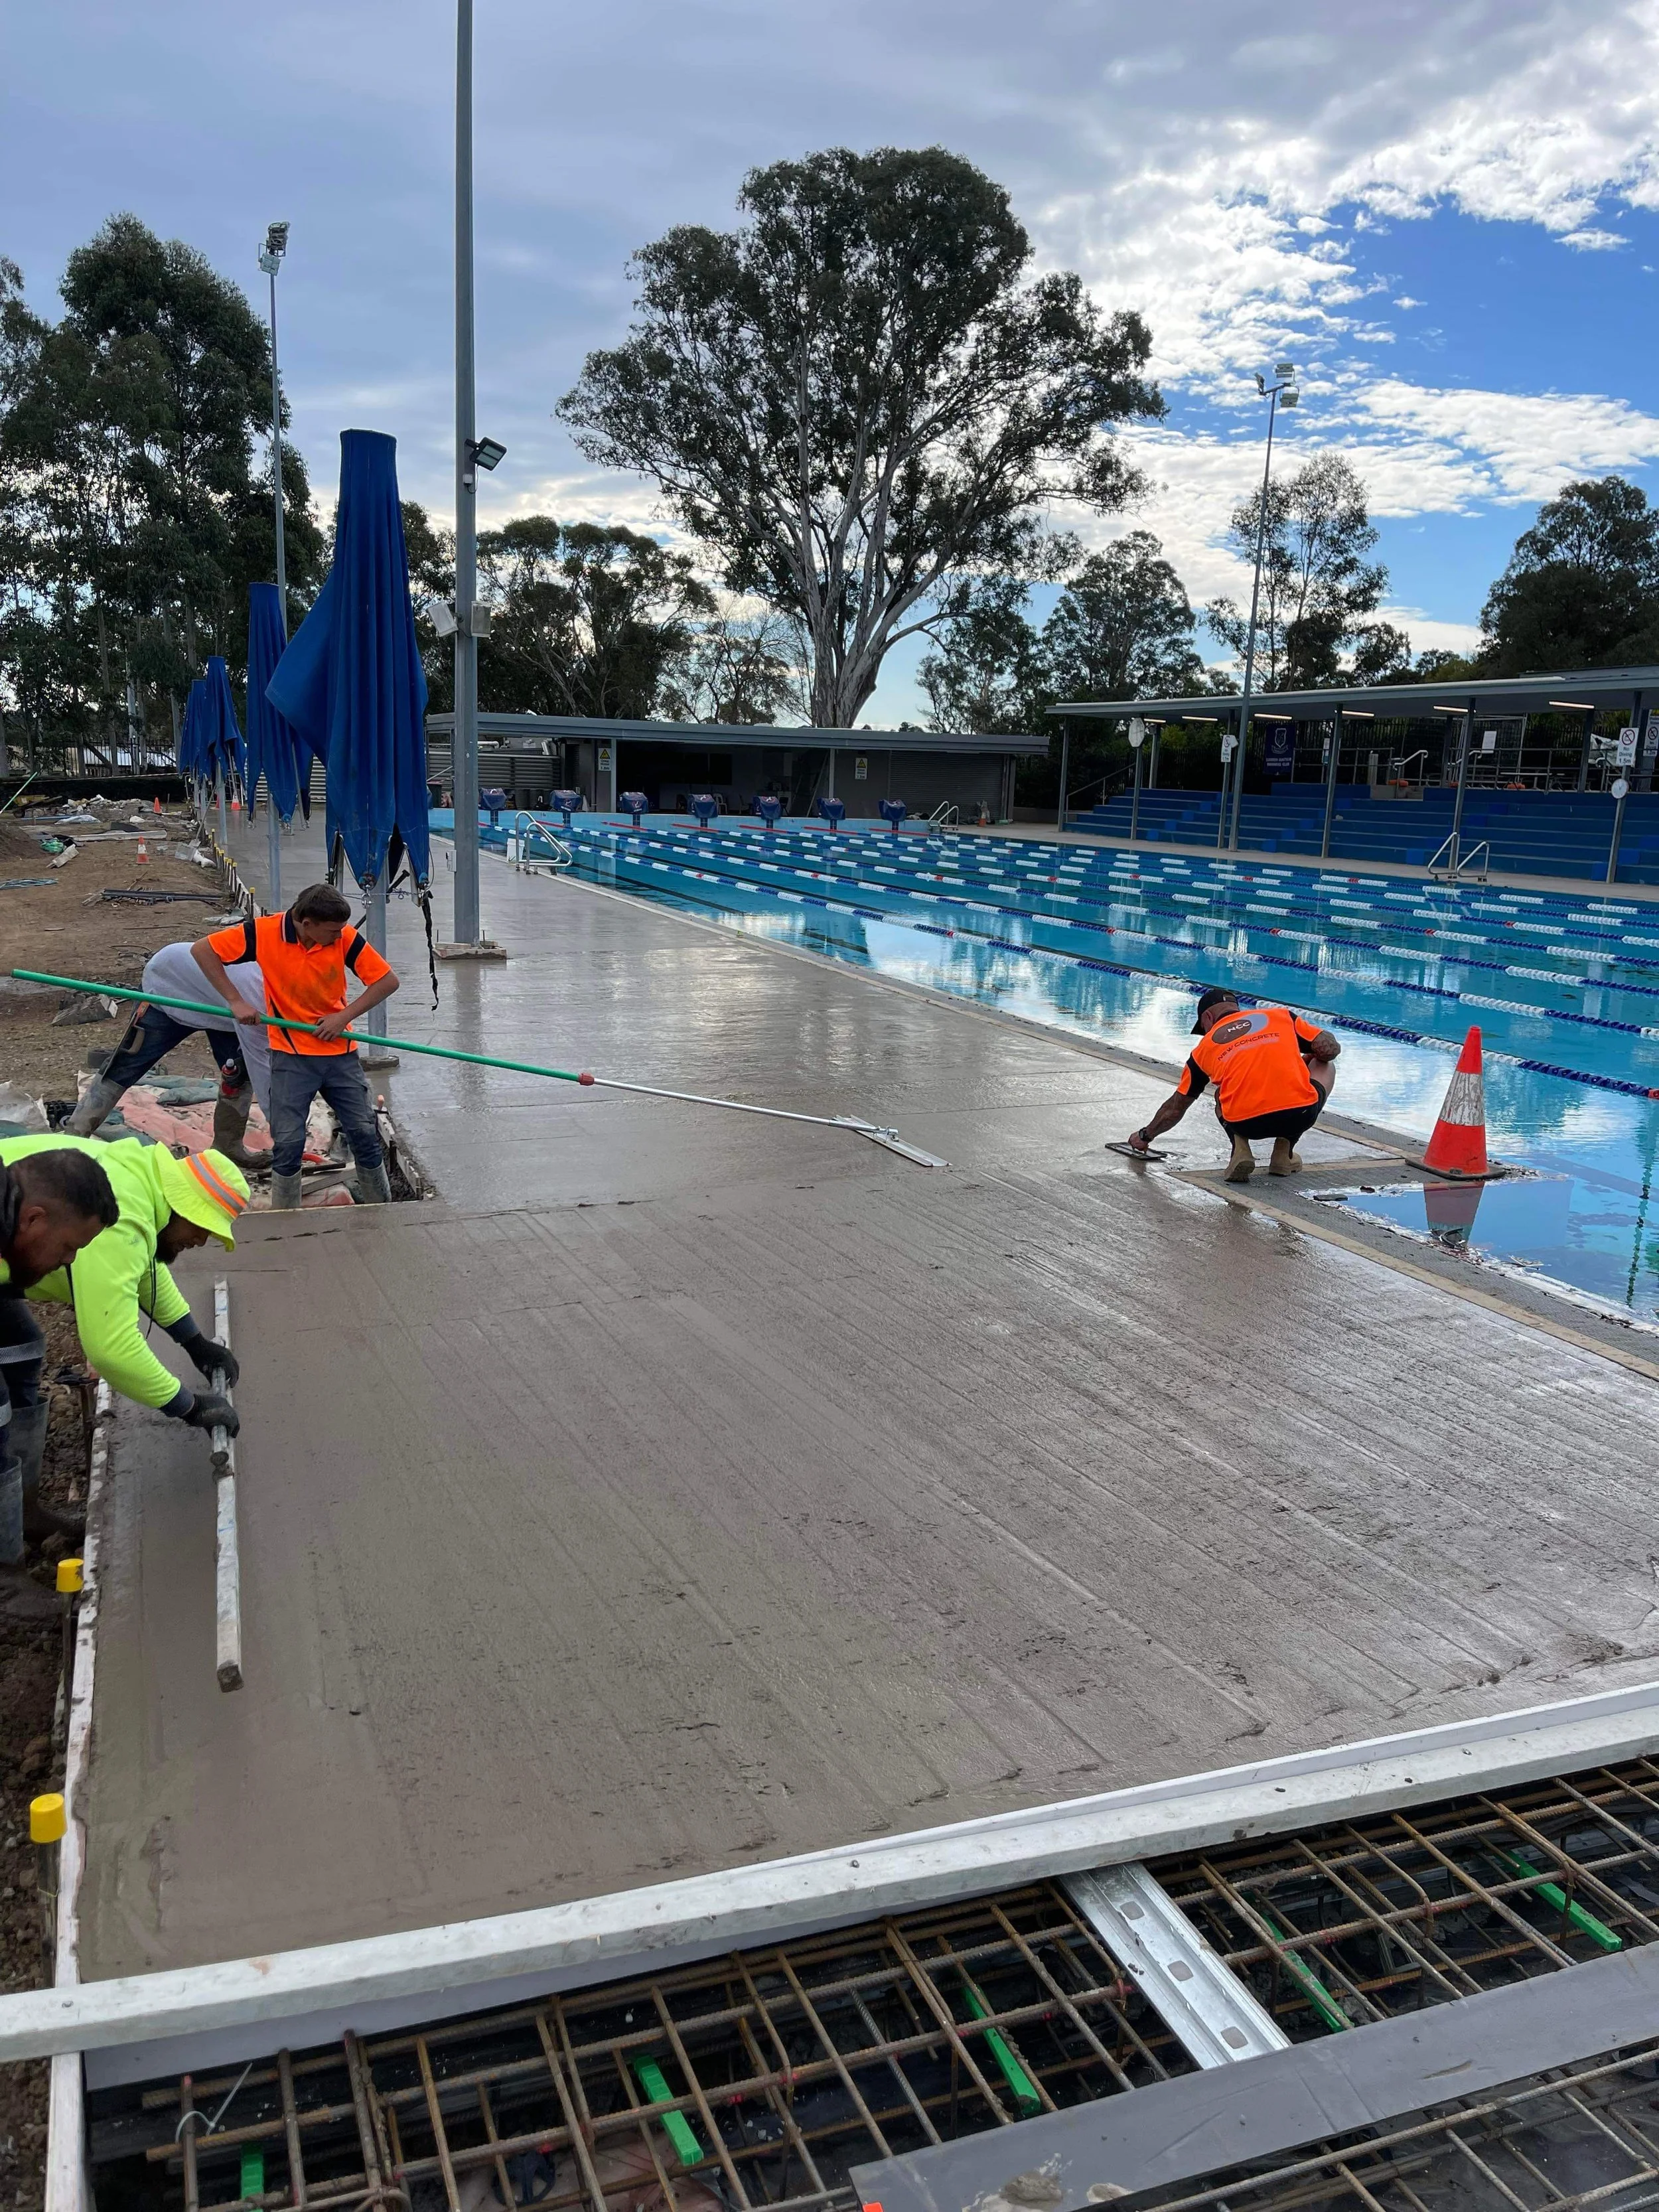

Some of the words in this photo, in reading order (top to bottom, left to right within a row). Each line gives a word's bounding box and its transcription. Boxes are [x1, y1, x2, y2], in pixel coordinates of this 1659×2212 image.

[1227, 1021, 1250, 1033] NCC
[1218, 1045, 1233, 1061] NEW
[1234, 1033, 1279, 1047] CONCRETE
